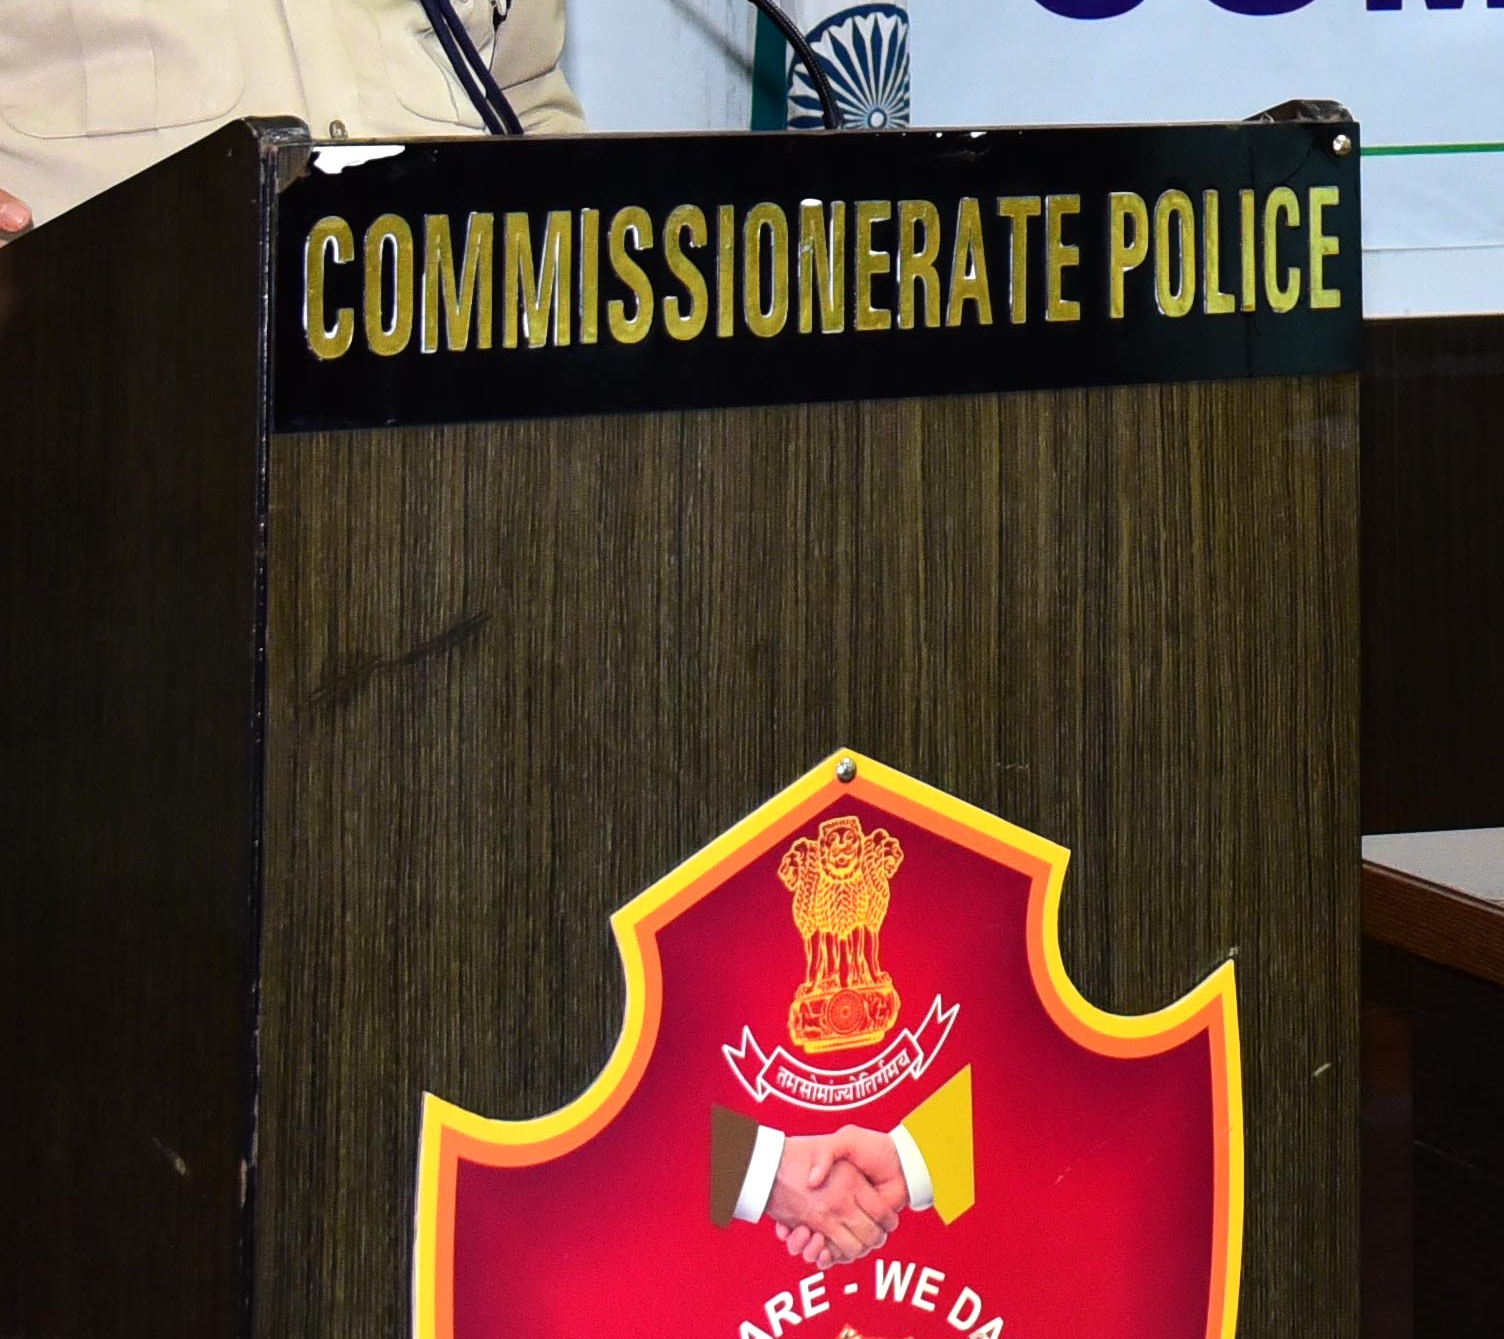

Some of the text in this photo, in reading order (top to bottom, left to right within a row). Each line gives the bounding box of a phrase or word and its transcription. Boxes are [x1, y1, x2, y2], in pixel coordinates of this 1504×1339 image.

[302, 184, 1343, 363] COMMISSIONERATE POLICE
[737, 1271, 831, 1339] ARE
[874, 1258, 946, 1313] WE
[946, 1285, 1005, 1339] DA
